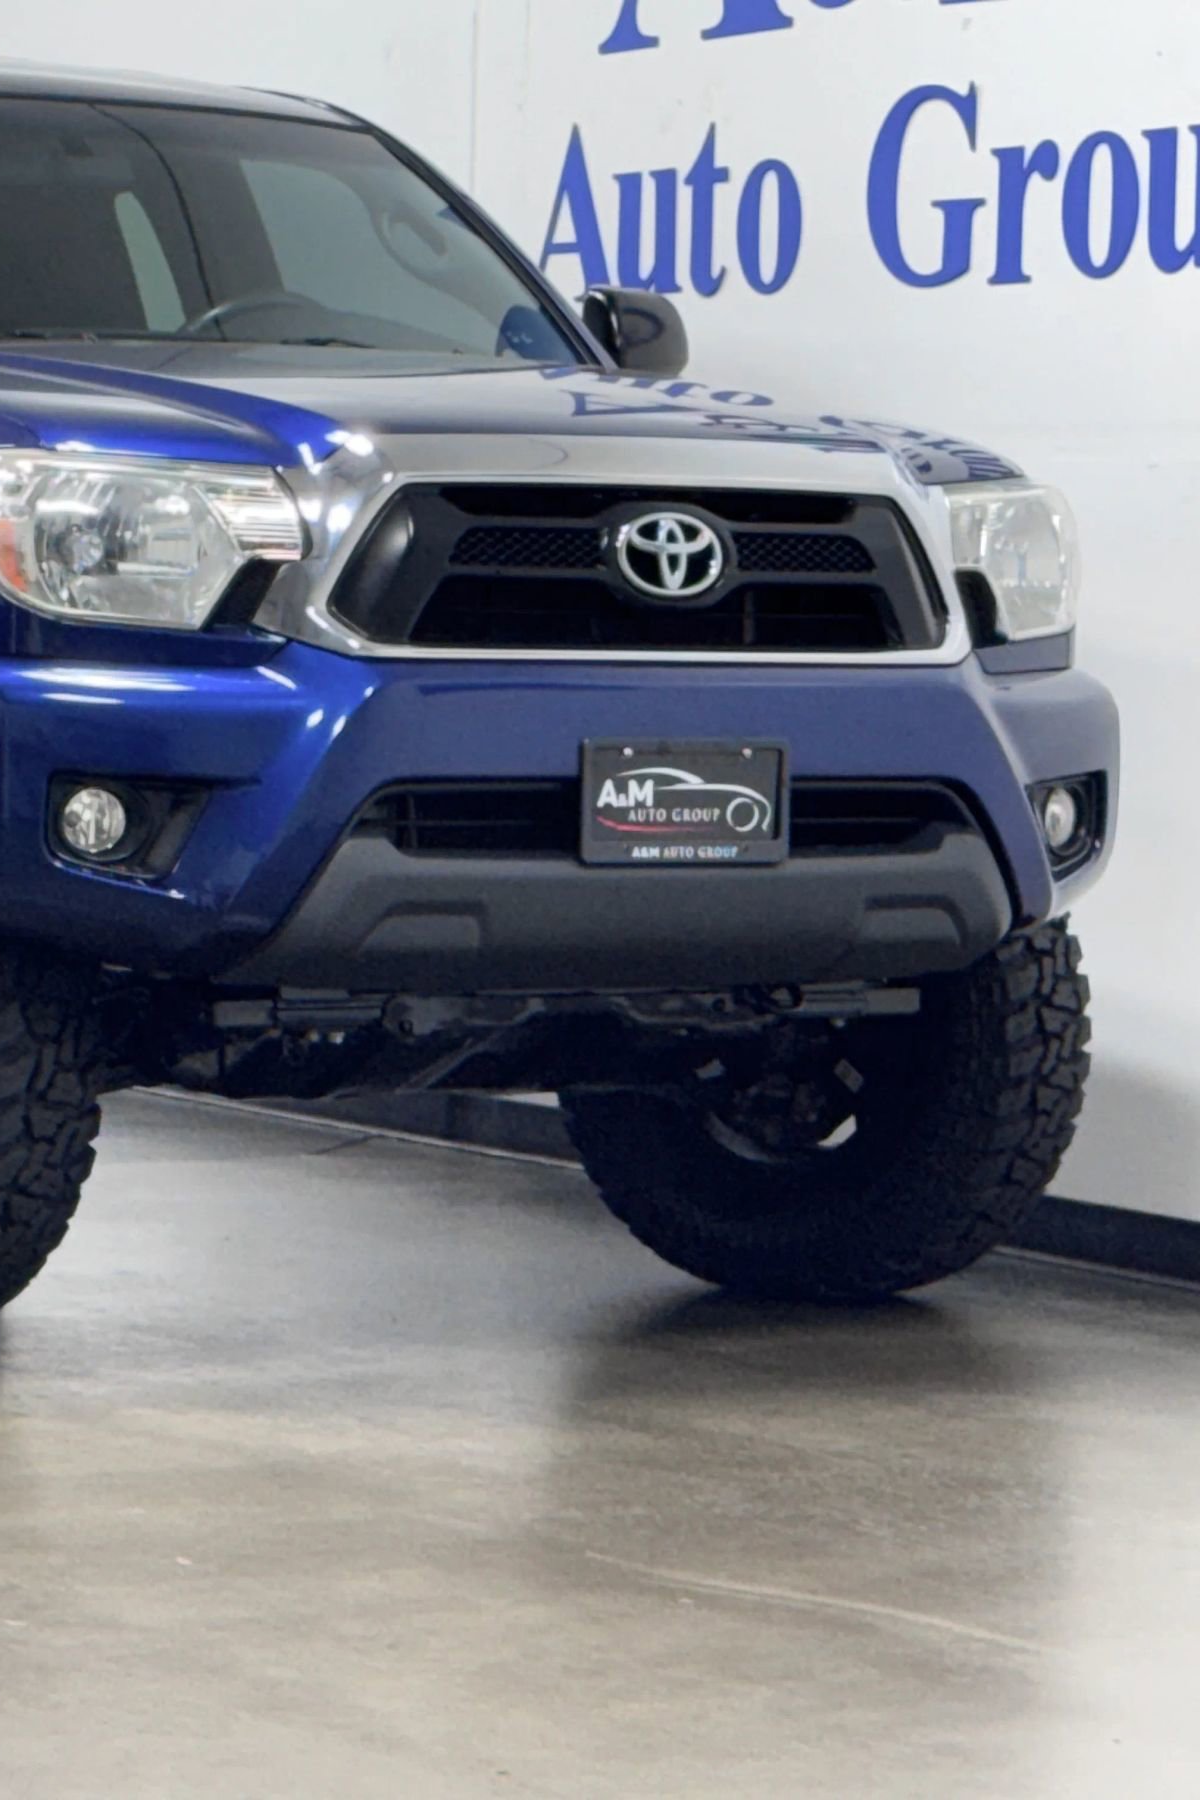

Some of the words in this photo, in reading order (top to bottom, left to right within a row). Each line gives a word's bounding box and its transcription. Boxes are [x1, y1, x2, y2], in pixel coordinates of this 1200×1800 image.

[540, 122, 803, 299] Auto
[596, 778, 655, 808] A&M
[627, 808, 667, 822] AUTO
[671, 807, 721, 822] GROUP
[663, 846, 694, 858] AUTO
[697, 846, 738, 858] GROUP
